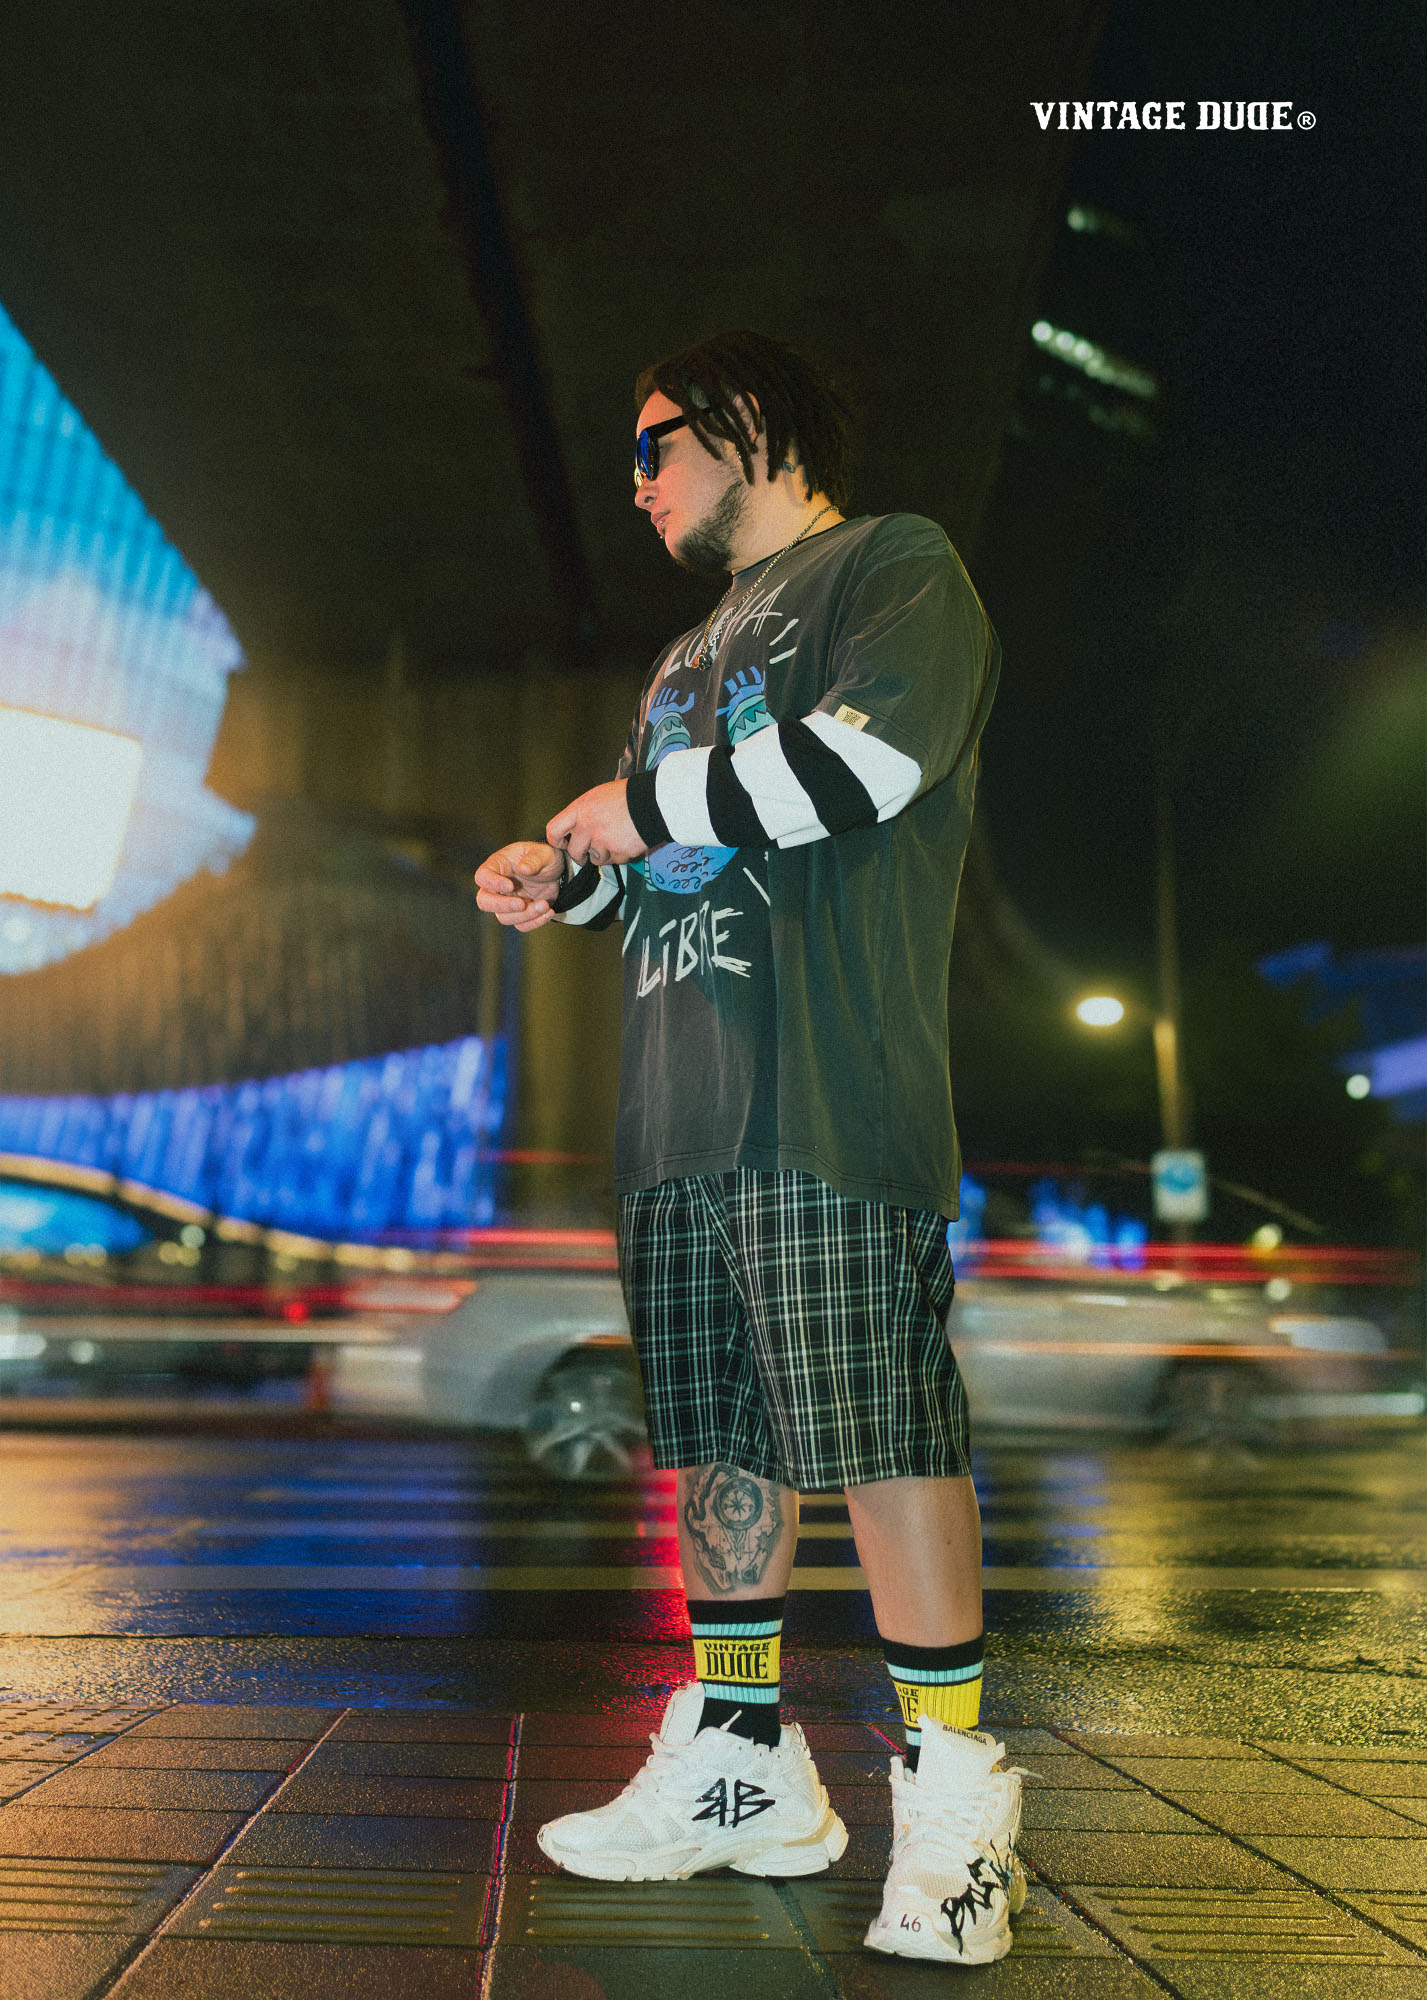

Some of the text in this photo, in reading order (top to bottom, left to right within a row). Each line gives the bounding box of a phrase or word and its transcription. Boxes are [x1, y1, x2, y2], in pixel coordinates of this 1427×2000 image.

[704, 1642, 770, 1652] VINTAGE
[706, 1652, 769, 1679] DUDE
[943, 1724, 988, 1746] BALENCIAGA
[900, 1914, 921, 1932] 46
